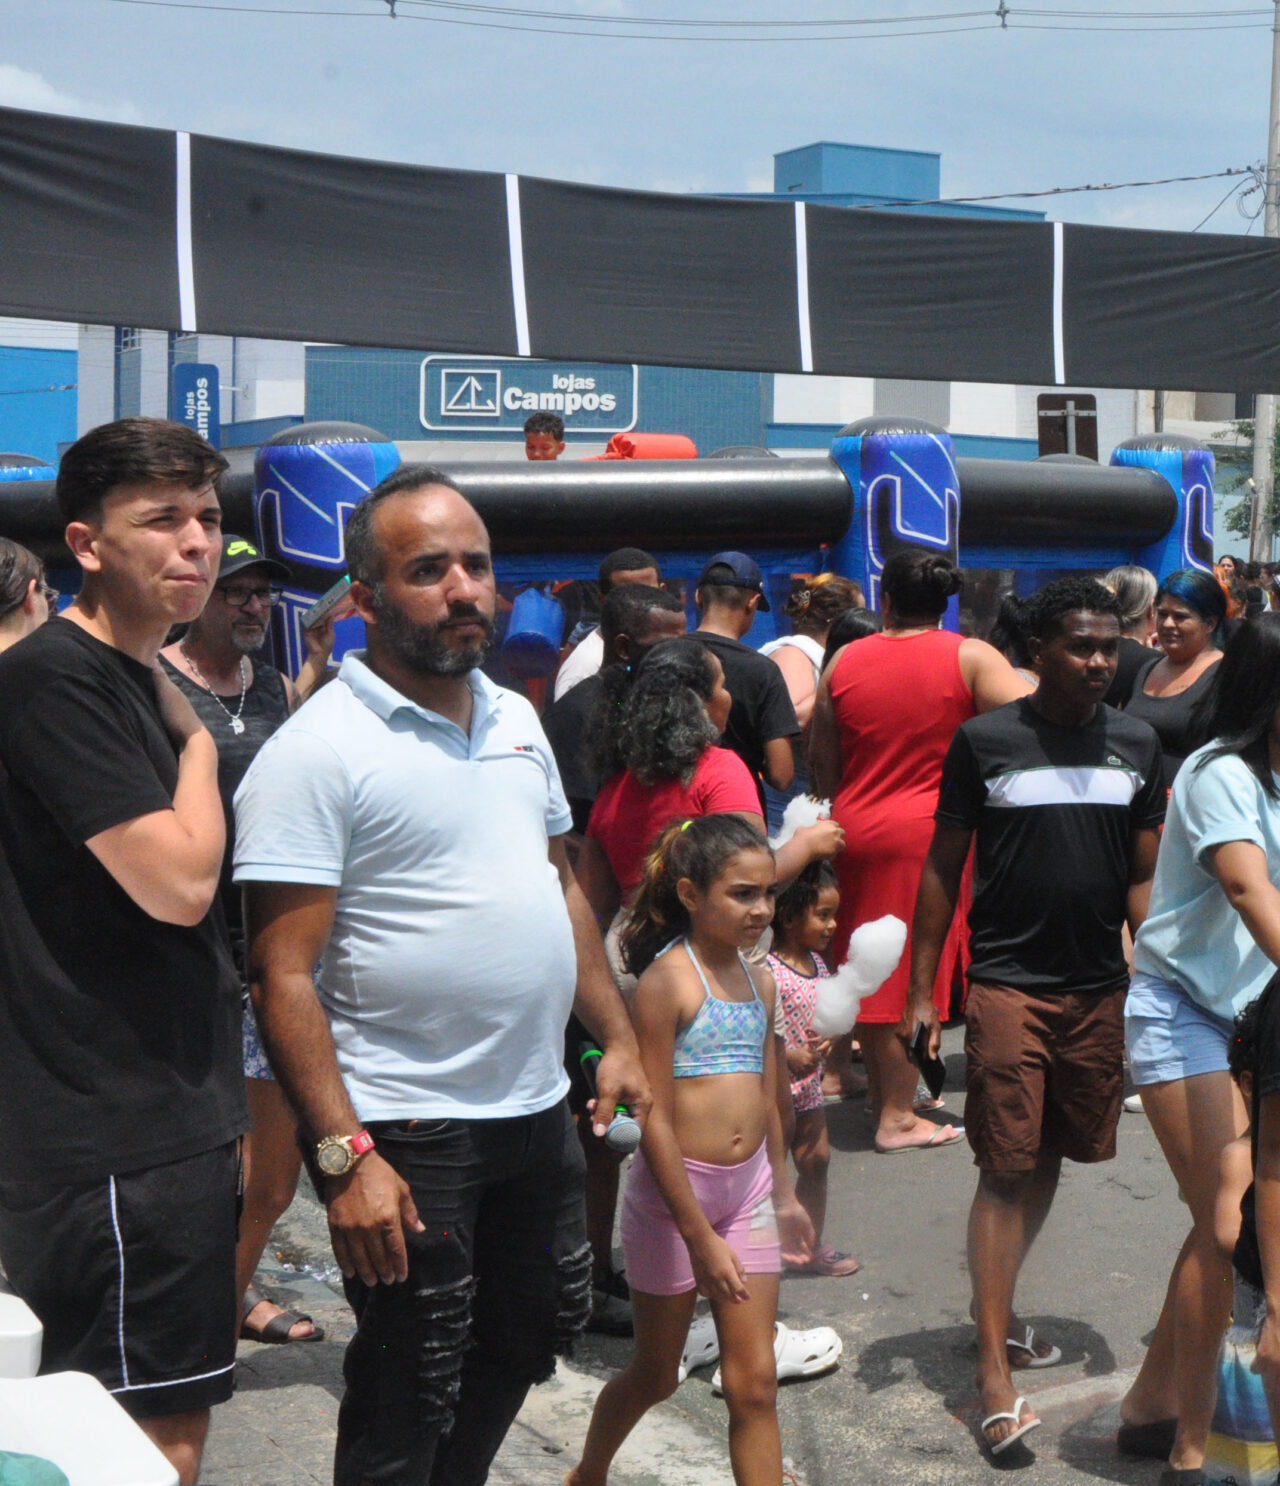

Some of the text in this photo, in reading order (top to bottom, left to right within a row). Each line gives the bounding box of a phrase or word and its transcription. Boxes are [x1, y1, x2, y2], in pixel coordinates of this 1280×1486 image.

[552, 373, 596, 393] lojas
[184, 391, 197, 420] lojas
[196, 377, 212, 441] ampos
[503, 387, 617, 415] Campos
